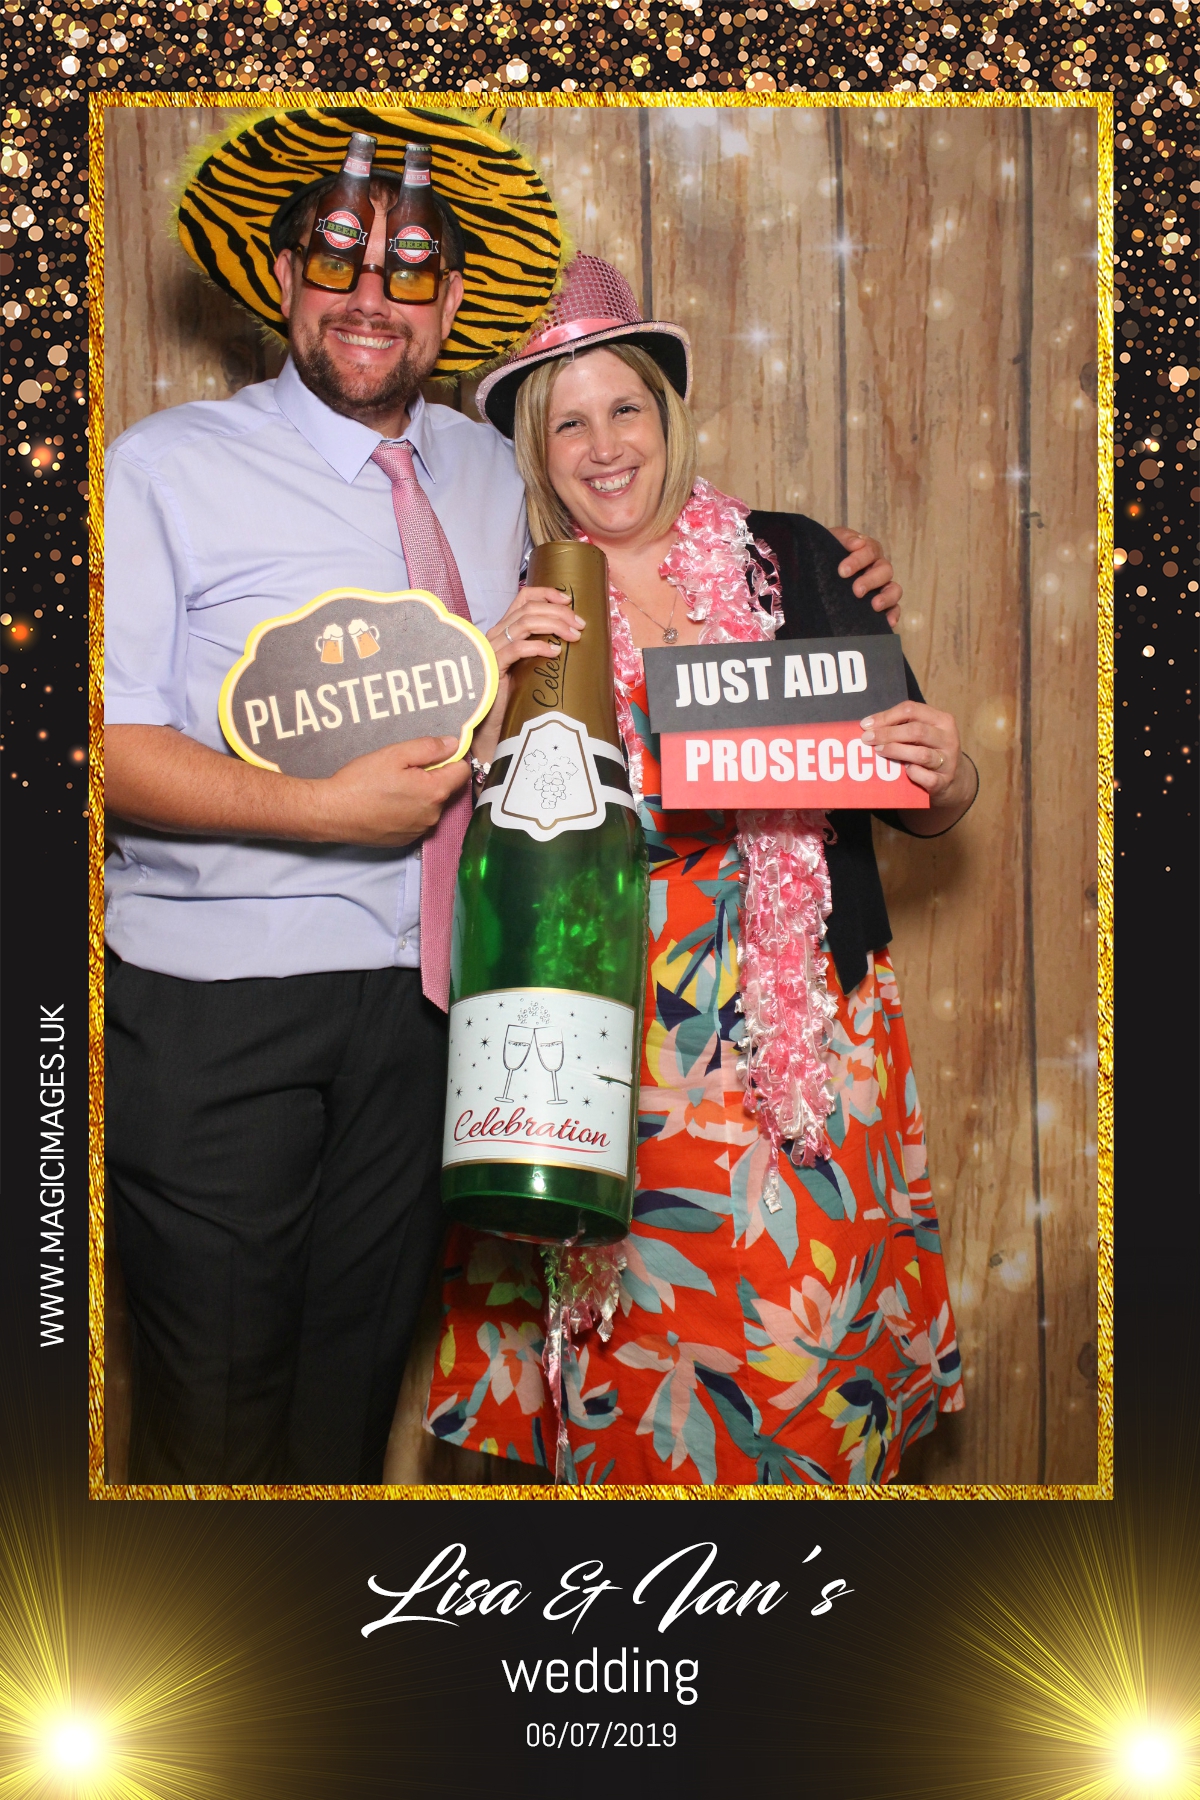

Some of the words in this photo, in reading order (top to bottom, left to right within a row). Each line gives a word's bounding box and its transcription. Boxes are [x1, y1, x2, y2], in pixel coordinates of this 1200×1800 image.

[326, 222, 357, 238] BEER
[399, 240, 429, 249] BEER
[676, 657, 772, 708] JUST
[784, 650, 868, 698] ADD
[244, 656, 475, 745] PLASTERED!
[453, 1106, 611, 1148] Celebration
